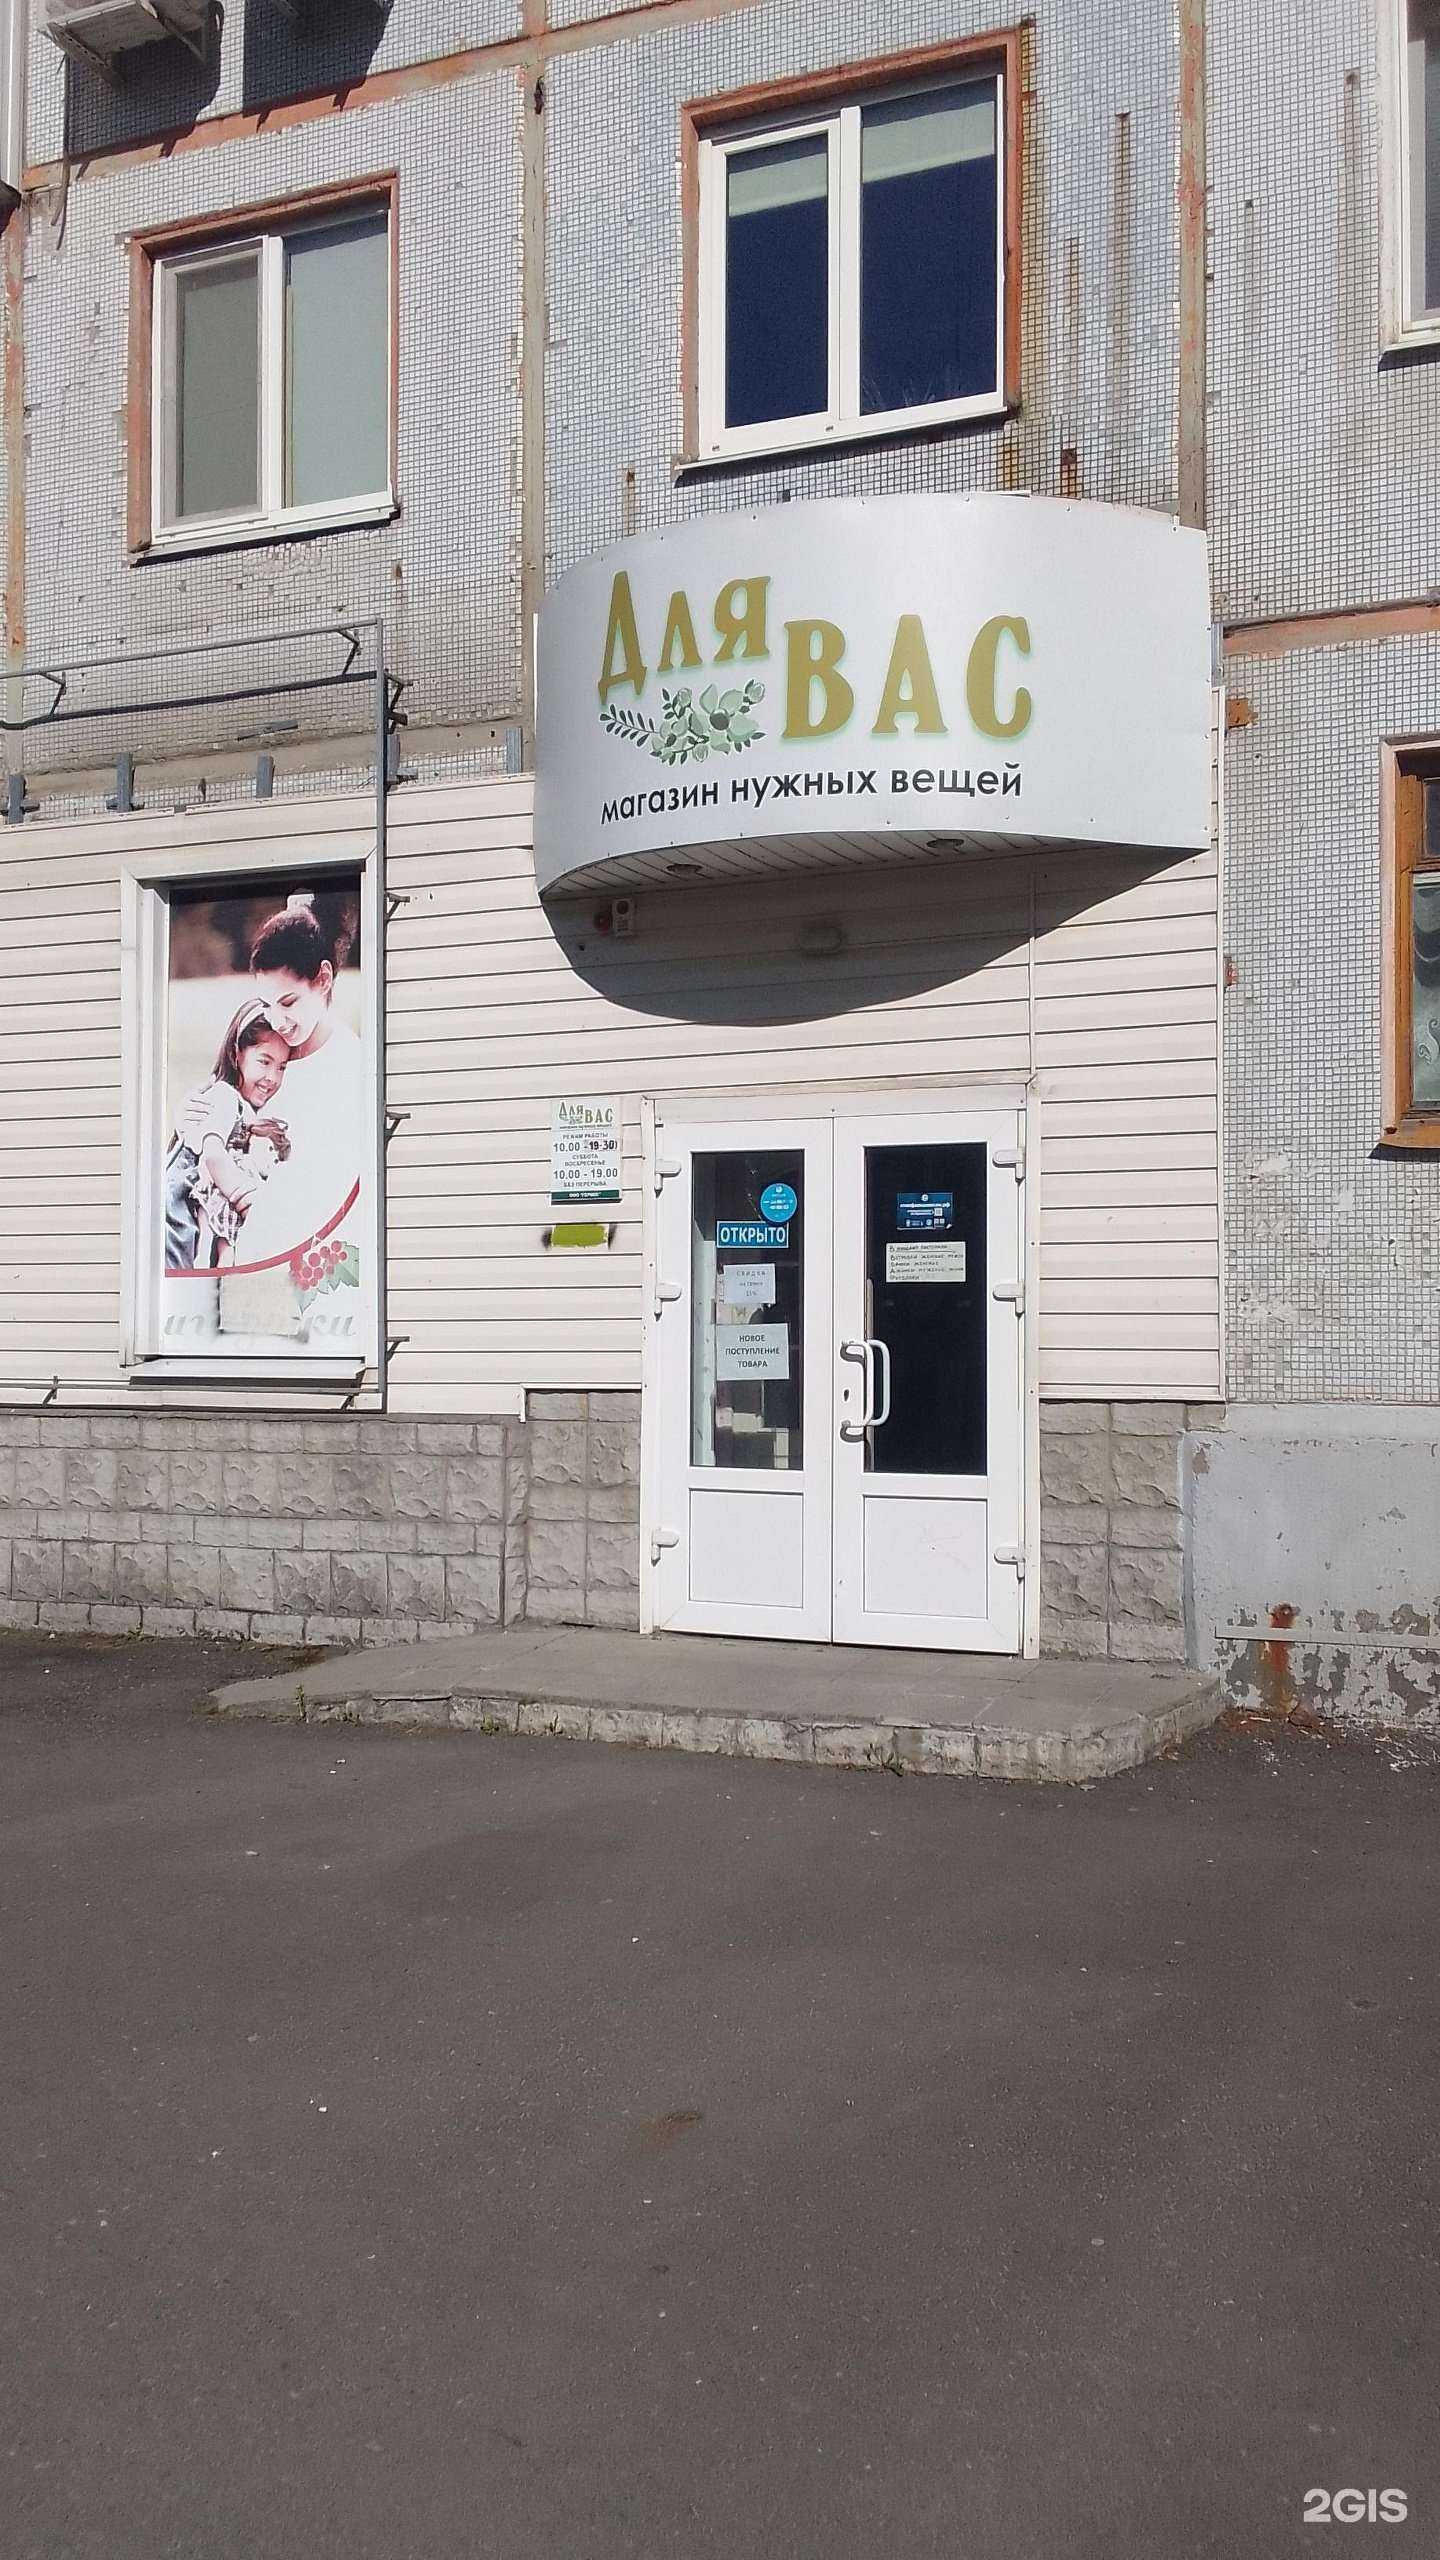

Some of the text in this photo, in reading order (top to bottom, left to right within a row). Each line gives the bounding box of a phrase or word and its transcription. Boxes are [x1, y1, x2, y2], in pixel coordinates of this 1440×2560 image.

[782, 613, 1033, 740] ВАС
[600, 762, 1023, 826] магазин нужных вещей
[585, 1108, 613, 1124] ВАС
[553, 1142, 580, 1152] 10.00
[553, 1169, 580, 1179] 10.00
[590, 1168, 618, 1178] 19.00
[720, 1226, 786, 1243] ОТКРЫТО
[739, 1334, 766, 1342] НОВОЕ
[725, 1347, 780, 1356] ПОСТУПЛЕНИЕ
[738, 1360, 768, 1368] ТОВАРА
